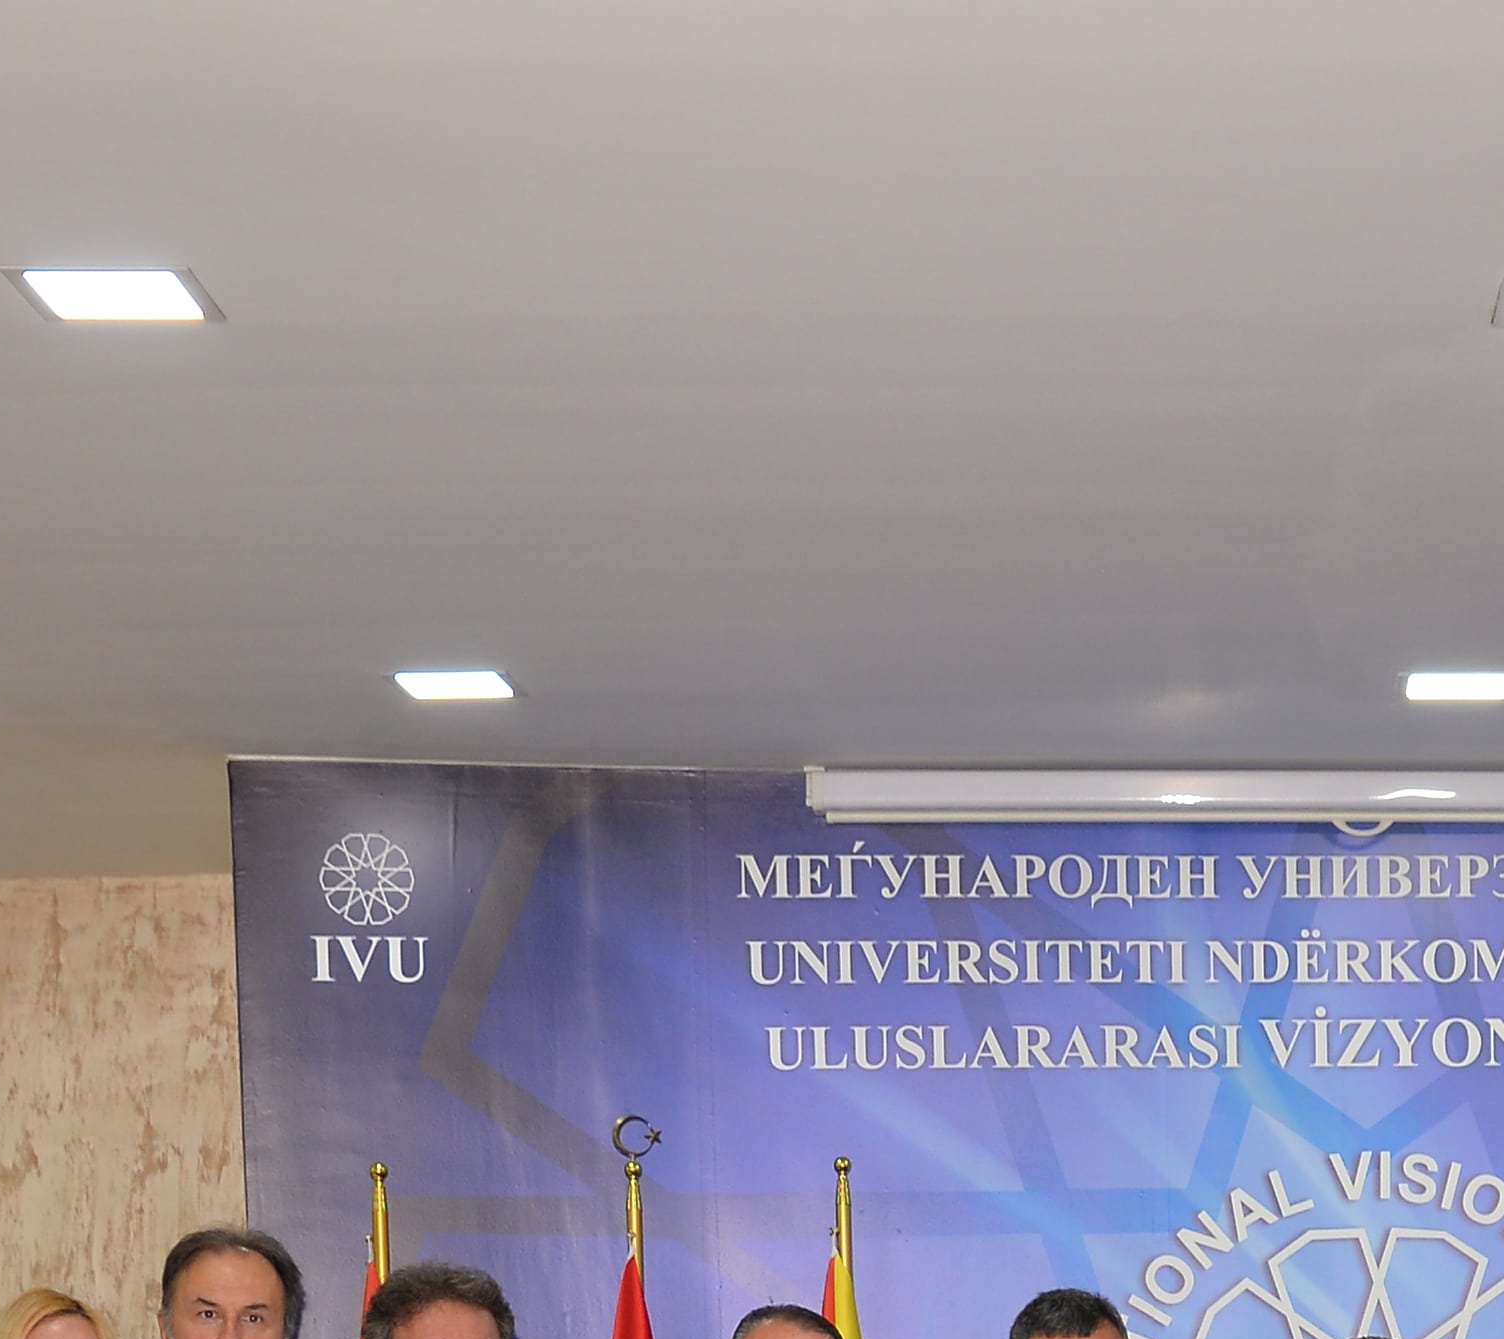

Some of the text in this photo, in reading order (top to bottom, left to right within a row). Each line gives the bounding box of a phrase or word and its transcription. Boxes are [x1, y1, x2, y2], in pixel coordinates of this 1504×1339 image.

[737, 841, 1219, 908] МЕЃУНАРОДЕН
[310, 935, 429, 984] IVU
[746, 939, 1187, 985] UNIVERSITETI
[766, 1024, 1242, 1071] ULUSLARARASI
